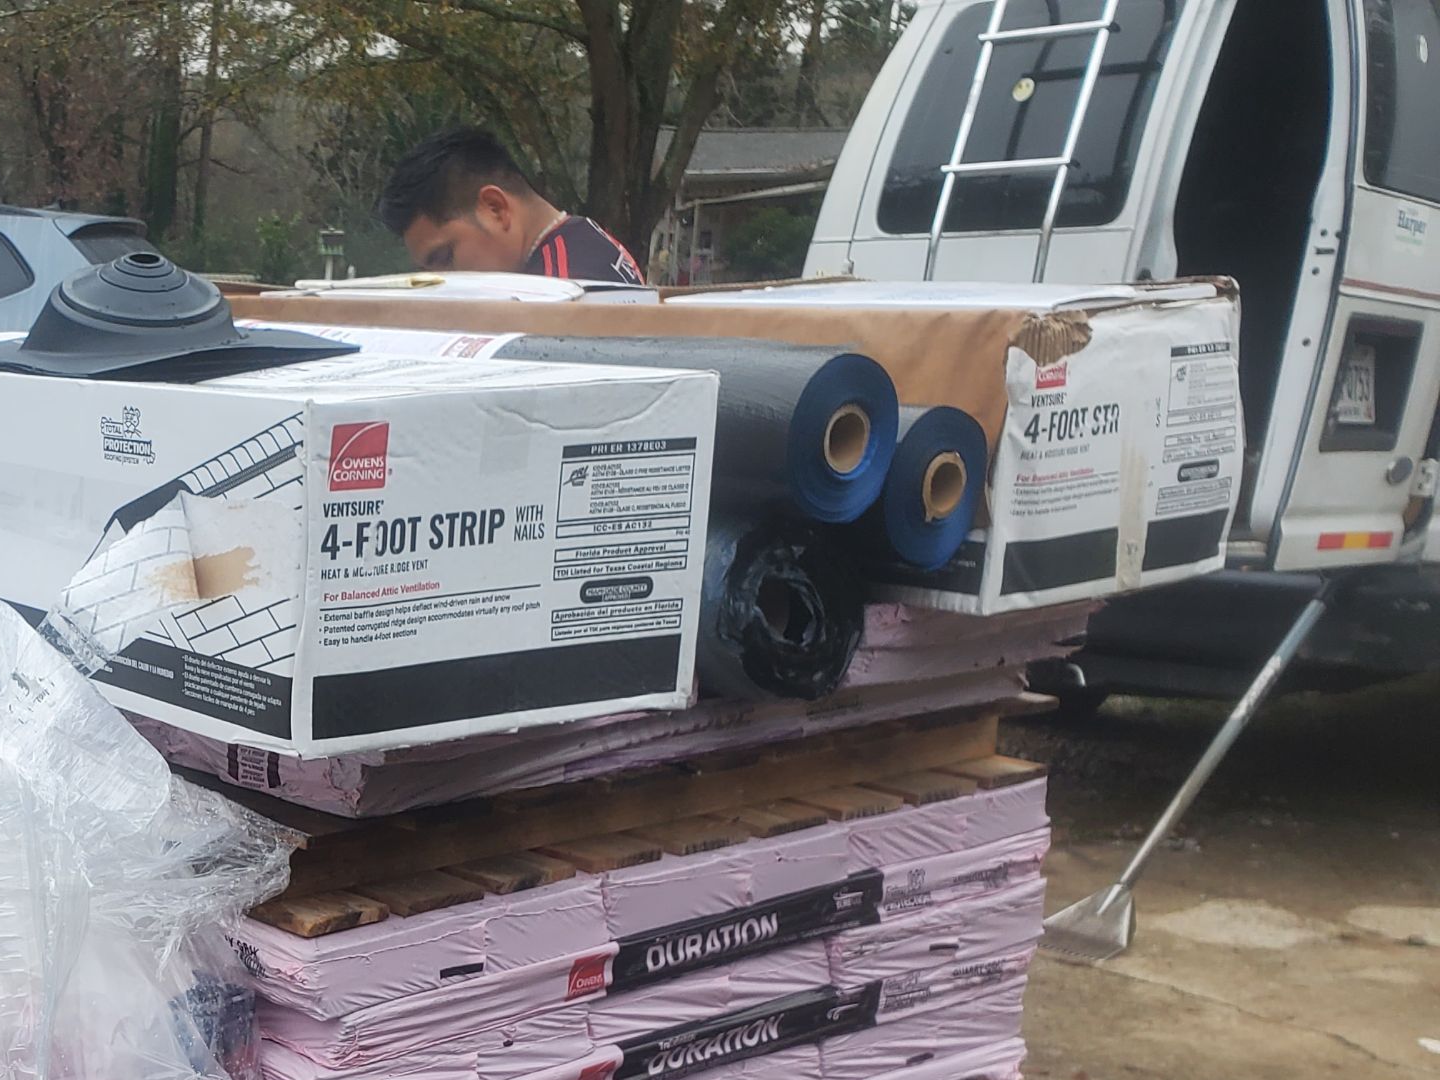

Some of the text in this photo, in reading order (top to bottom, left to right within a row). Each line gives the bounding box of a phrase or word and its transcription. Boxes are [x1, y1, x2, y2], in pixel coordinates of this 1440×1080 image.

[104, 438, 151, 456] PROTECTION
[342, 456, 384, 469] OWENS
[333, 468, 384, 482] CORNING
[516, 504, 543, 523] WITH
[321, 508, 505, 560] 4-FOOT STRIP
[514, 523, 545, 542] NAILS
[575, 543, 666, 558] Florida Product Approval
[321, 568, 341, 580] HEAT
[344, 568, 349, 578] &
[412, 559, 428, 571] VENT
[324, 580, 440, 602] For Balanced Attic Ventilation
[324, 611, 353, 622] External
[354, 609, 374, 620] baffle
[375, 607, 394, 619] design
[434, 598, 468, 609] wind-driven
[324, 624, 355, 635] Patented
[357, 620, 390, 633] corrugated
[407, 614, 427, 626] design
[324, 628, 418, 648] Easy to handle 4-foot sections
[646, 912, 779, 973] DURATION
[648, 1013, 784, 1076] DURATION
